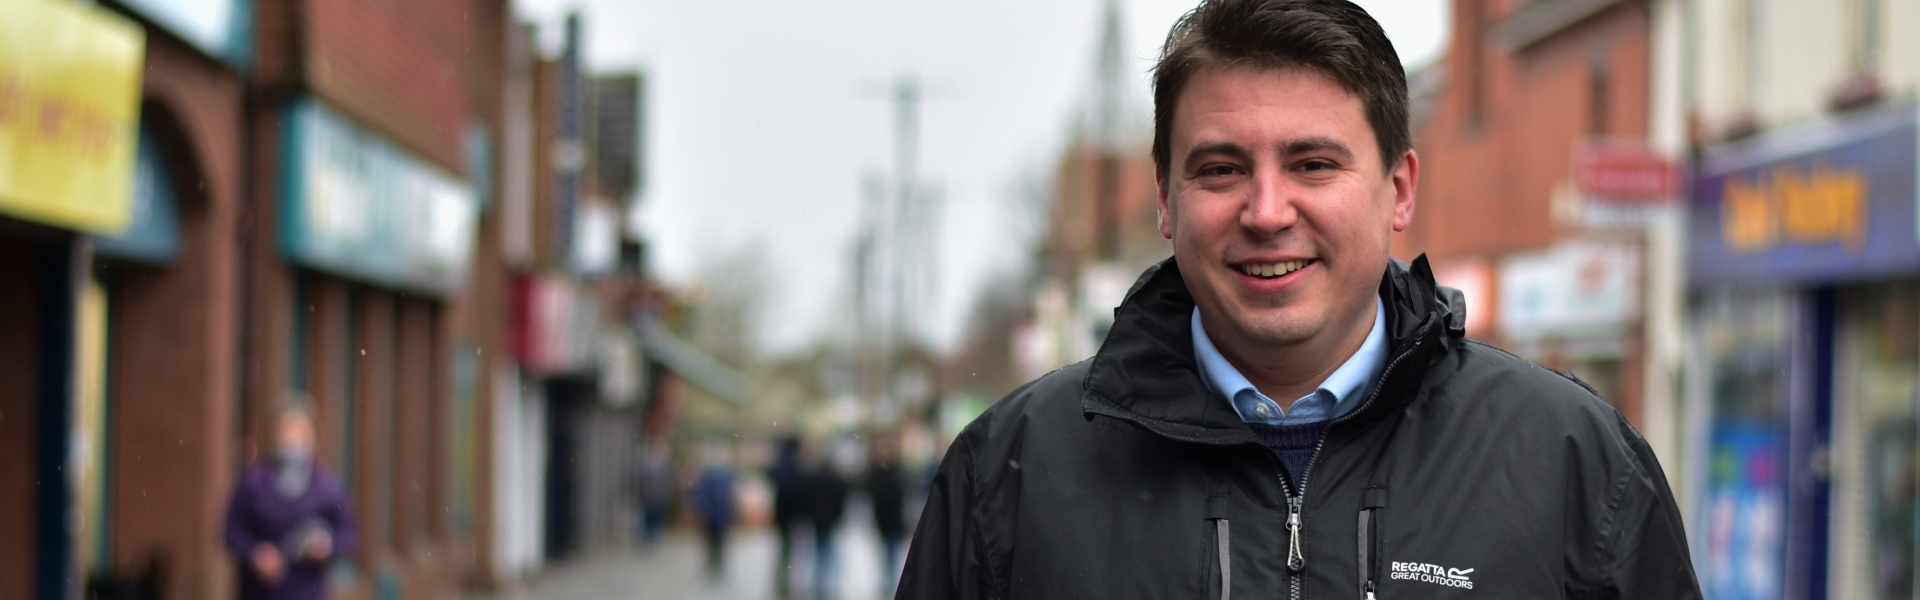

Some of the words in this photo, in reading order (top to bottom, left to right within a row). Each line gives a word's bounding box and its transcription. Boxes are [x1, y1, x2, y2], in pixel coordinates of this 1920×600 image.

[1392, 561, 1445, 576] REGATTA
[1391, 572, 1419, 581] GREAT
[1421, 574, 1473, 589] OUTDOORS
